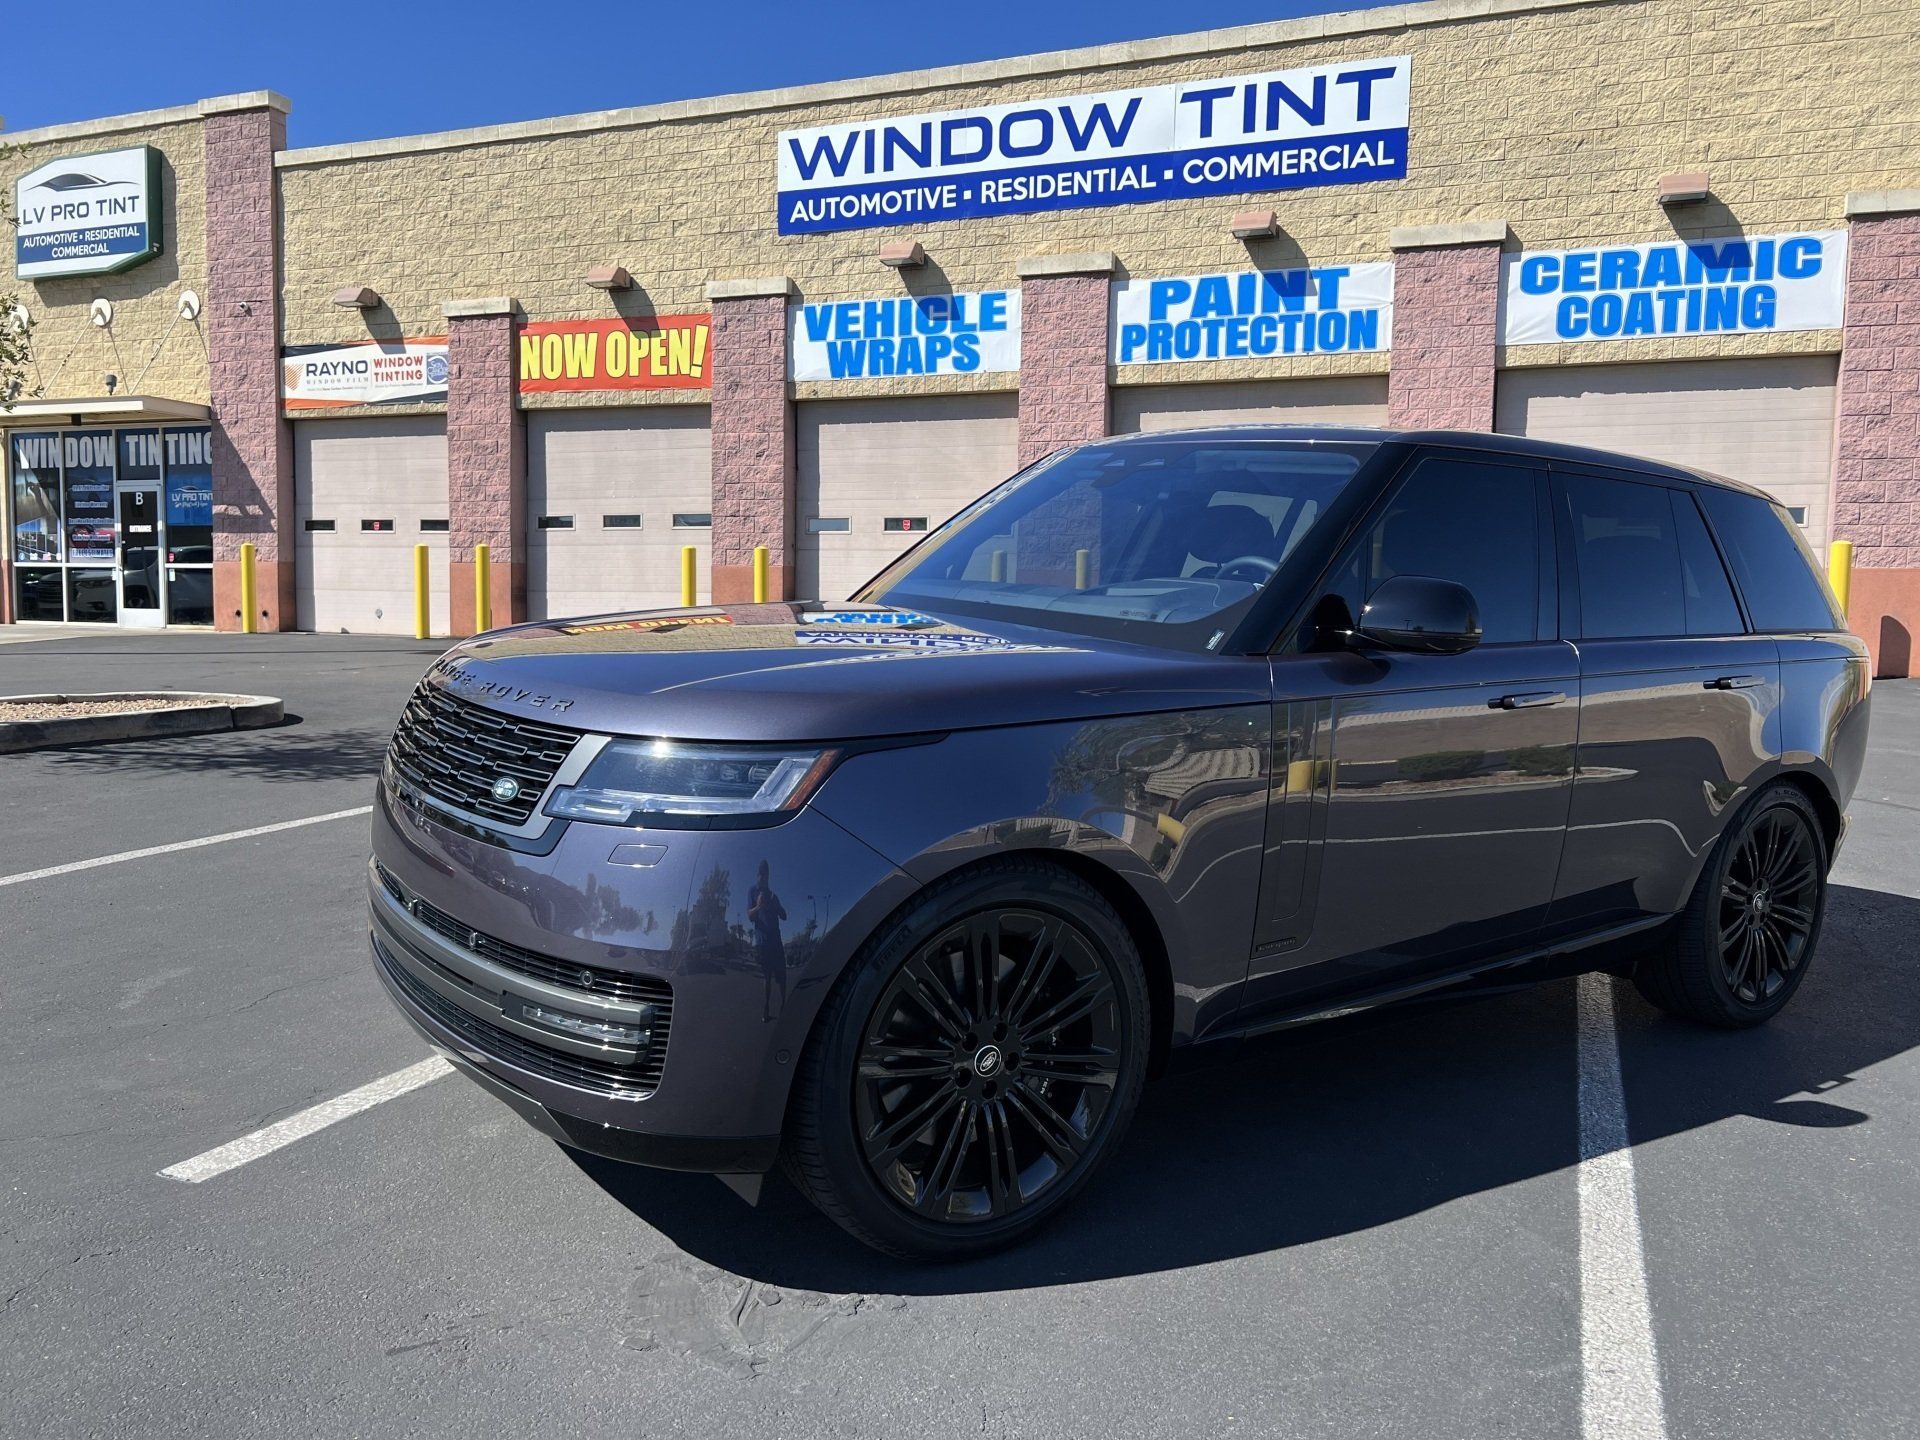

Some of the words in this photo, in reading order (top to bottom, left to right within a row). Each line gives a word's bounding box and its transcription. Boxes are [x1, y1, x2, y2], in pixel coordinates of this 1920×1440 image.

[788, 96, 1143, 181] WINDOW
[1180, 66, 1397, 139] TINT
[789, 184, 957, 223] AUTOMOTIVE
[981, 164, 1157, 204] RESIDENTIAL
[1183, 140, 1395, 184] COMMERCIAL
[23, 206, 46, 225] LV
[51, 202, 90, 222] PRO
[96, 195, 140, 216] TINT
[23, 231, 78, 248] AUTOMOTIVE
[84, 225, 140, 243] RESIDENTIAL
[51, 242, 109, 258] COMMERCIAL
[1519, 236, 1823, 296] CERAMIC
[803, 292, 1008, 342] VEHICLE
[1149, 267, 1350, 321] PAINT
[1556, 283, 1777, 339] COATING
[519, 331, 598, 381] NOW
[605, 324, 709, 380] OPEN!
[826, 332, 981, 379] WRAPS
[1120, 308, 1379, 363] PROTECTION
[306, 359, 369, 377] RAYNO
[373, 355, 424, 368] WINDOW
[374, 369, 423, 382] TINTING
[19, 435, 113, 469] WINDOW
[135, 492, 144, 506] B
